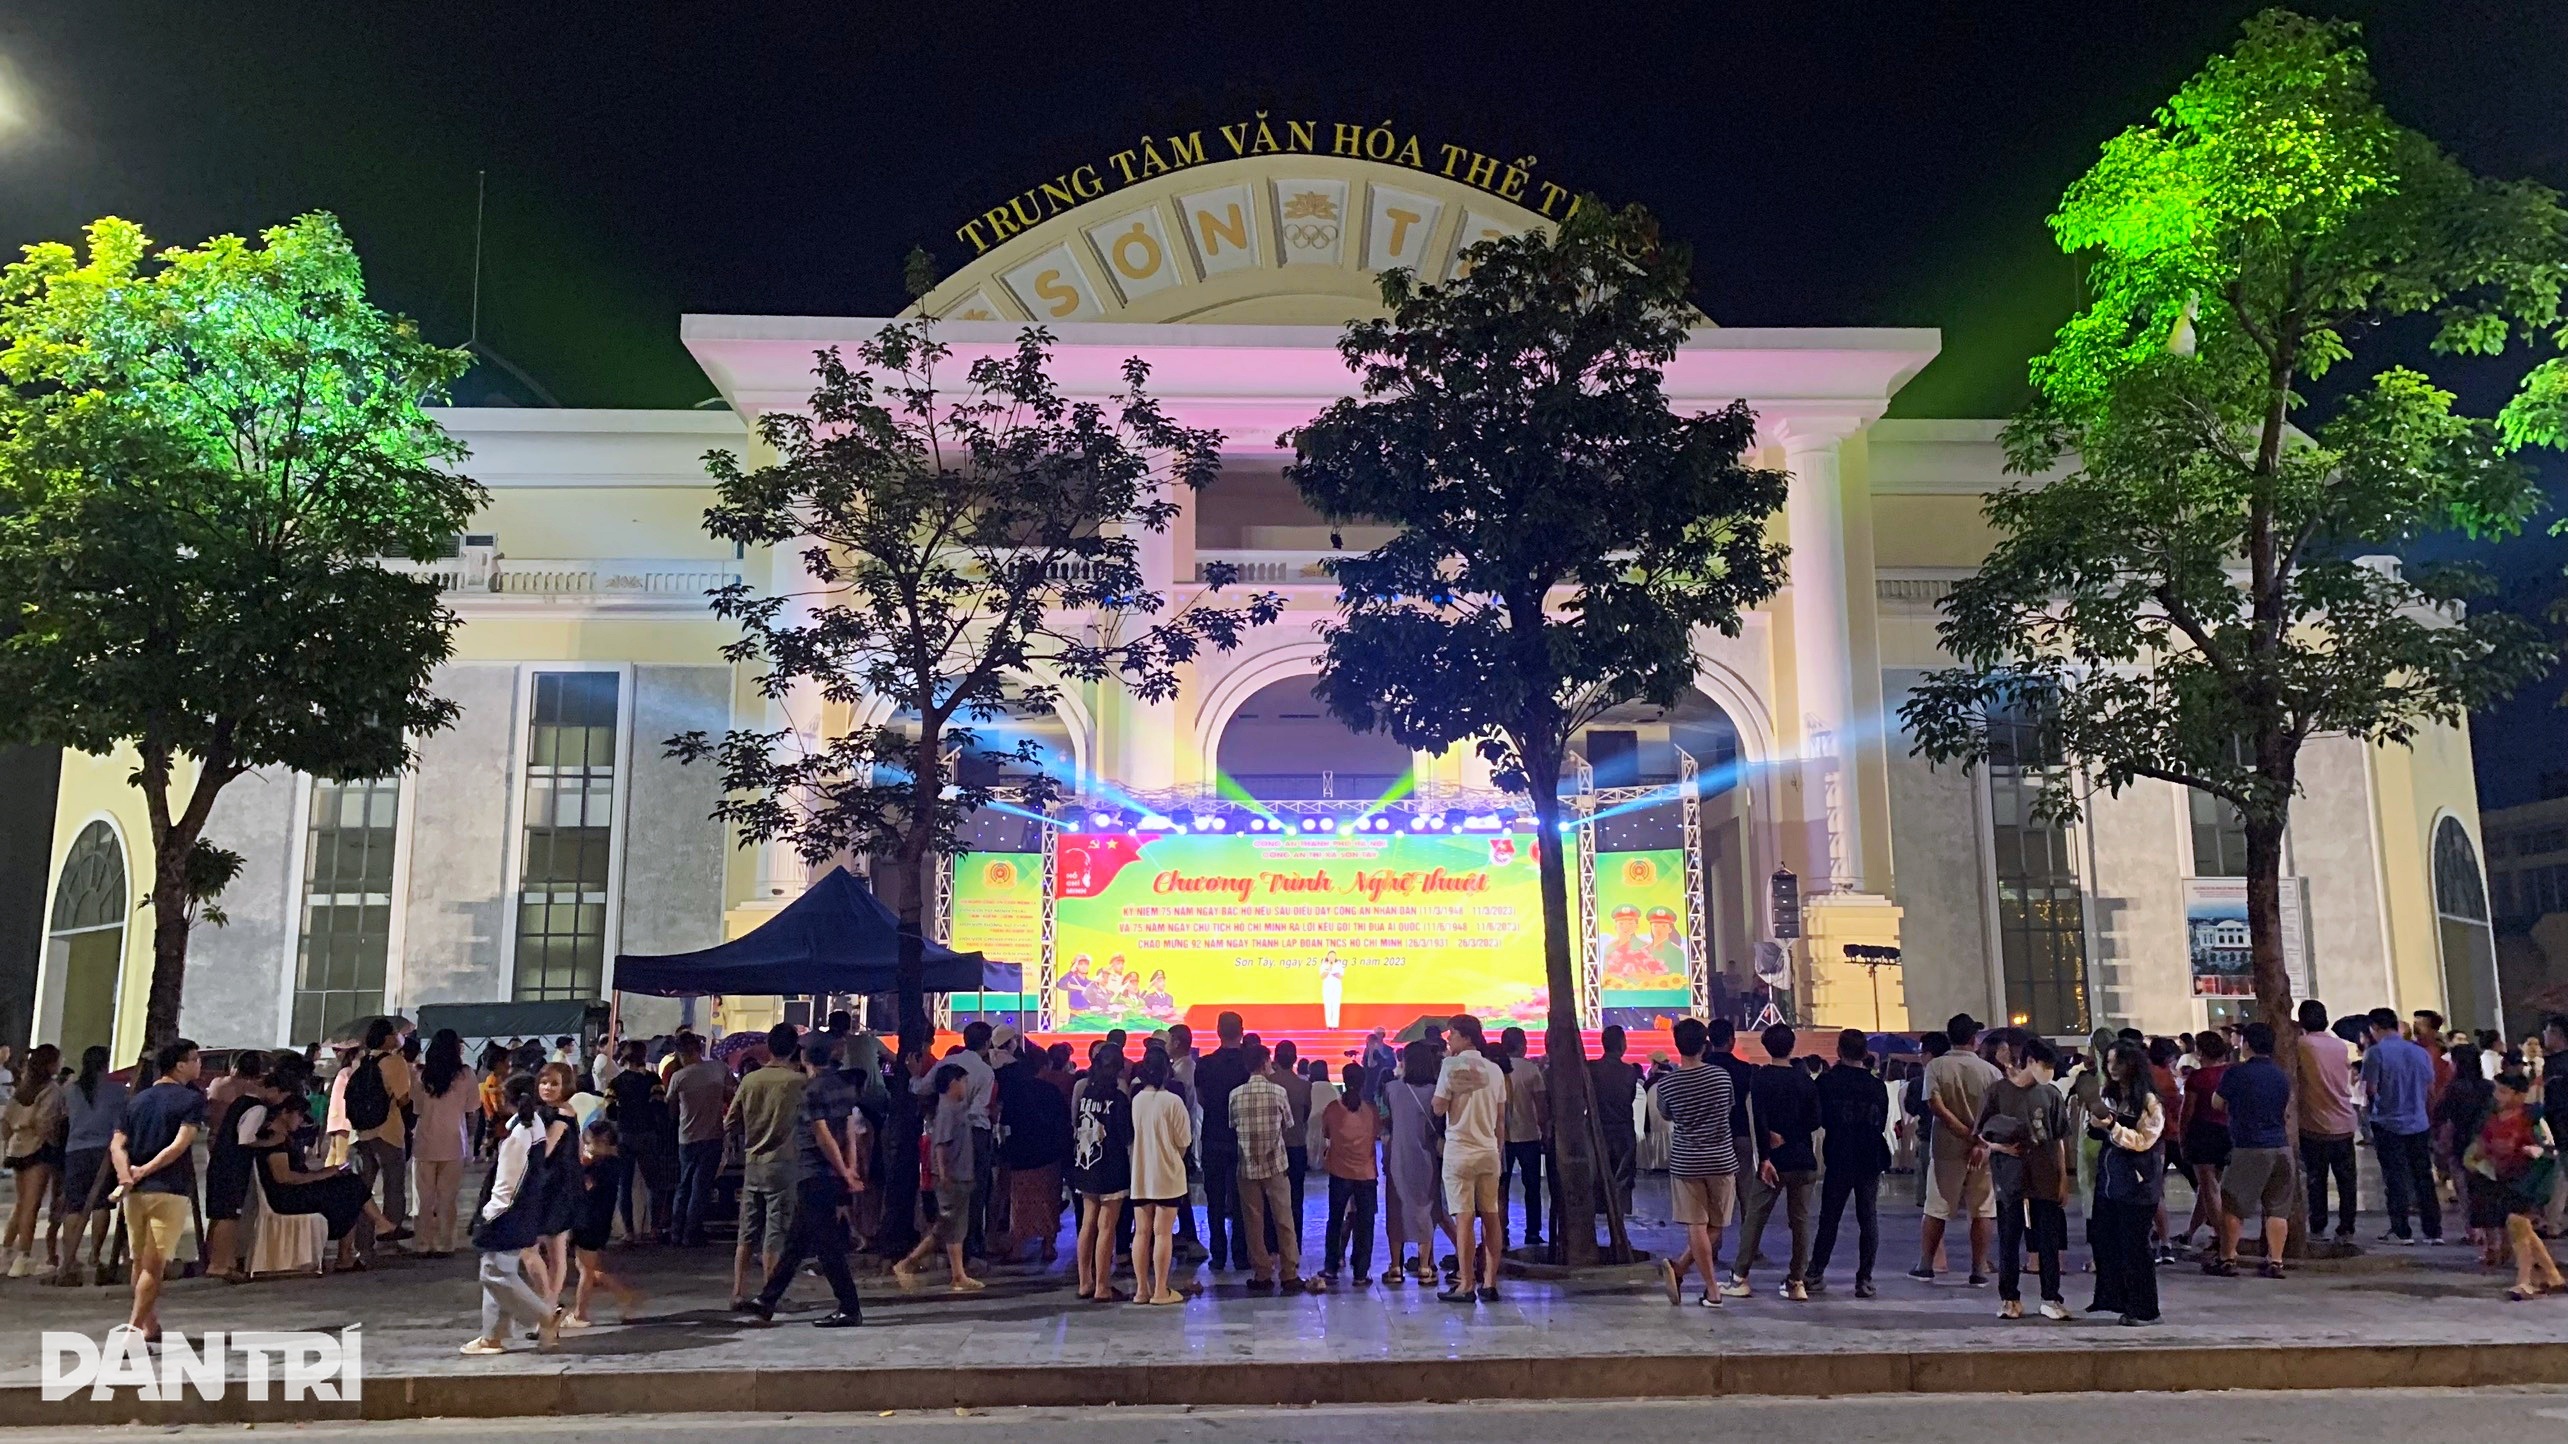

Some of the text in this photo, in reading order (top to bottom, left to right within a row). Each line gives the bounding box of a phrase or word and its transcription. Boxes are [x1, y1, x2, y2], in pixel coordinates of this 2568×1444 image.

[955, 110, 1538, 255] TRUNG TÂM VĂN HÓA THỂ
[1035, 203, 1248, 318] SƠN
[1153, 869, 1254, 902] Chương
[1259, 869, 1334, 894] Trình
[1191, 937, 1201, 948] 92
[1306, 958, 1317, 966] 25
[1351, 958, 1357, 966] 3
[1383, 957, 1406, 966] 2023
